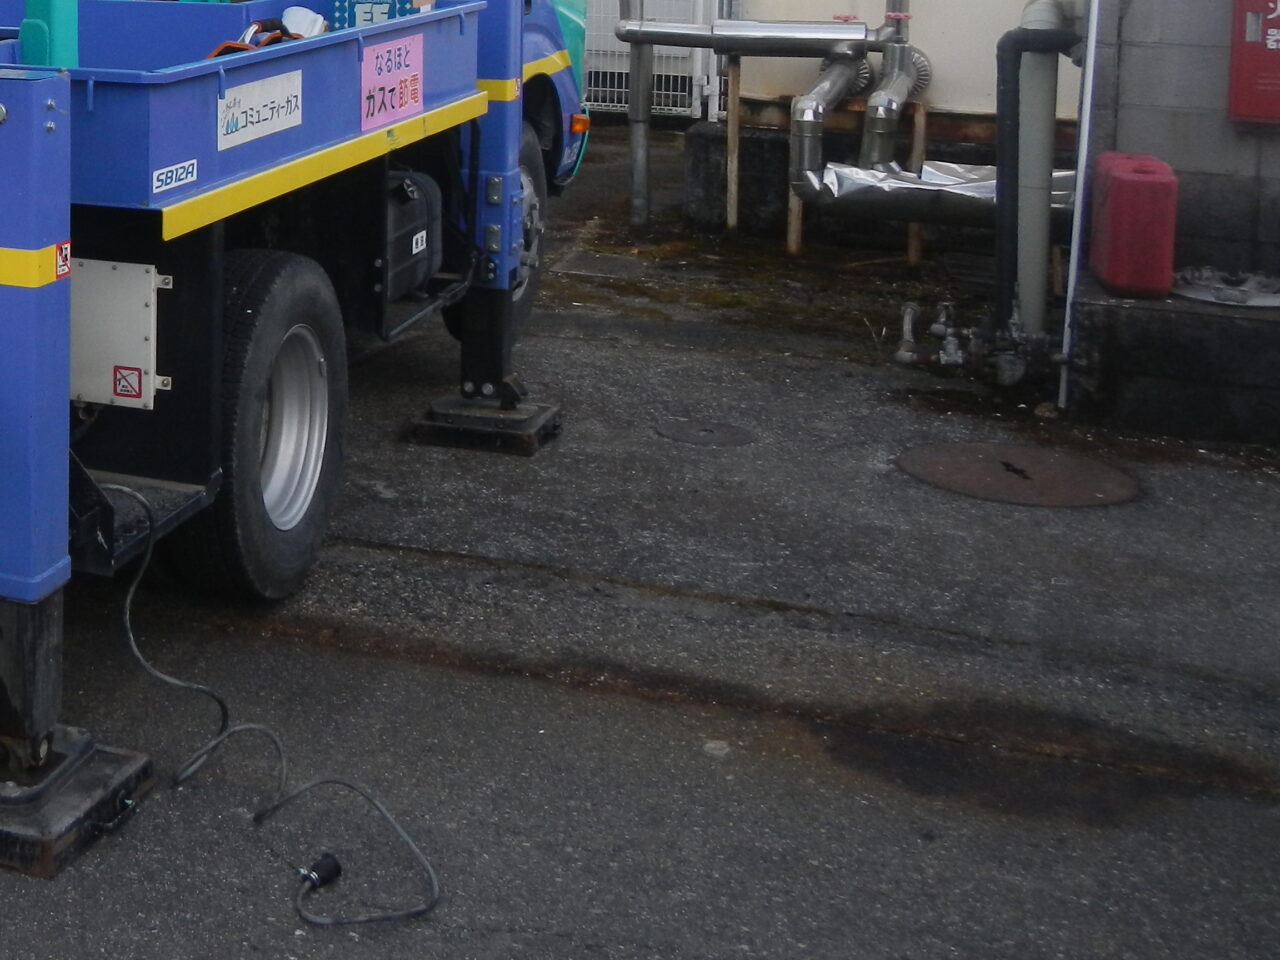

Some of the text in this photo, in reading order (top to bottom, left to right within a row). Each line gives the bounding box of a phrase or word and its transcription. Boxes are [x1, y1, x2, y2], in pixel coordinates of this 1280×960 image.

[375, 43, 412, 76] なるほど
[240, 93, 300, 129] コミュニティーガス
[365, 72, 419, 119] ガスで節電
[155, 163, 195, 189] SB12A
